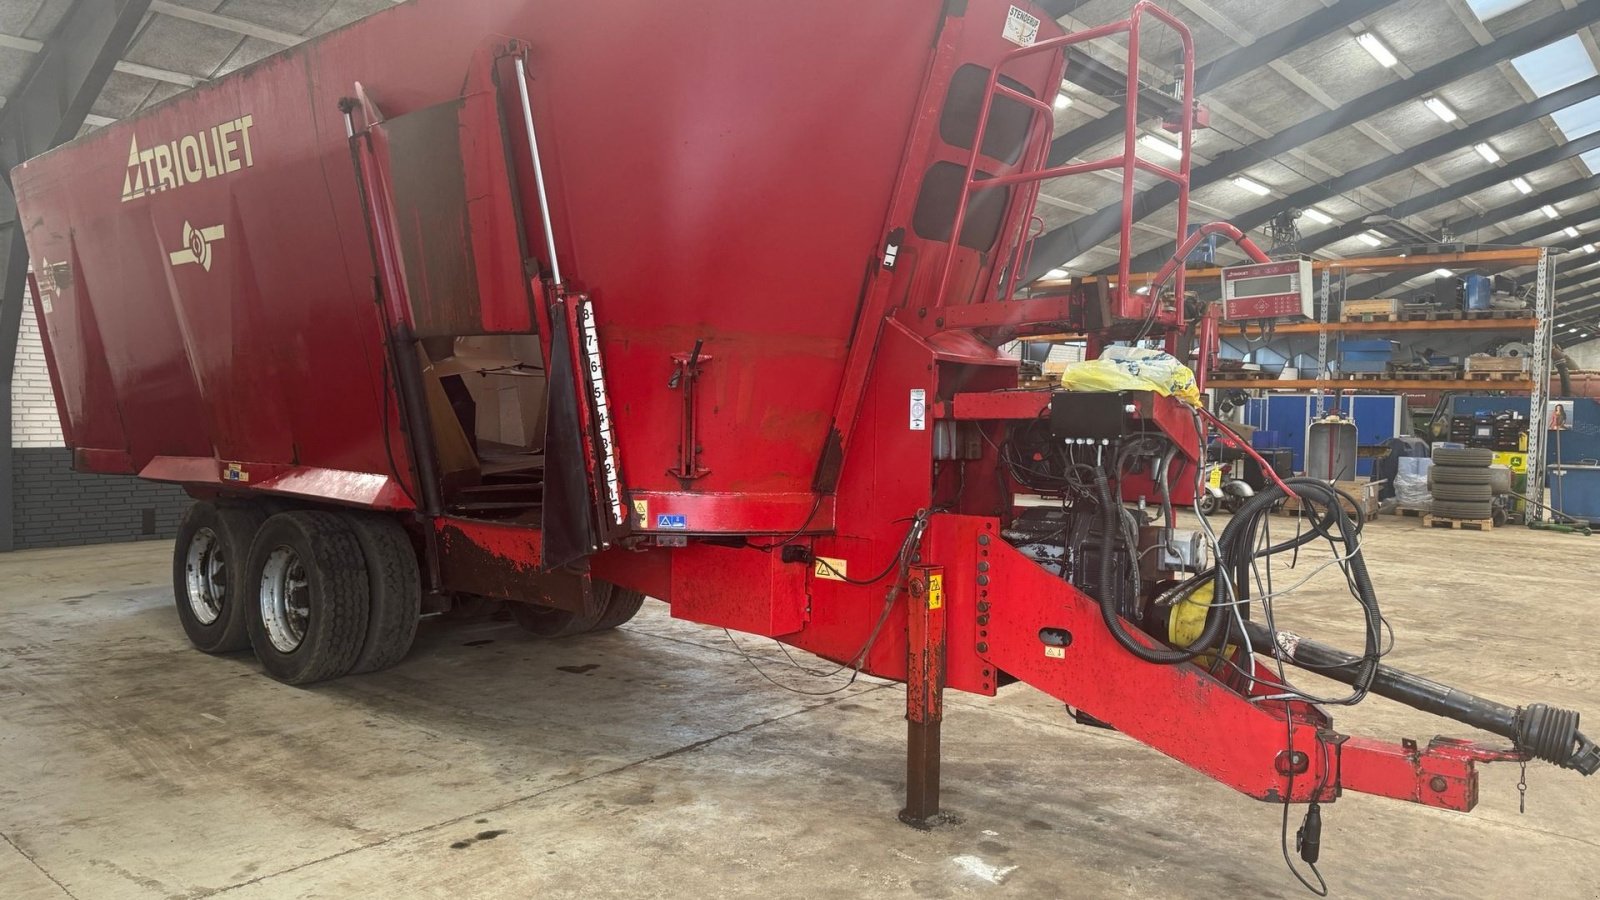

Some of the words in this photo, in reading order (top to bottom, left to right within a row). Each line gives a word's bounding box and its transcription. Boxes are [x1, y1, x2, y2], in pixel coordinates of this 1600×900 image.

[140, 114, 253, 195] TRIOLIET
[583, 308, 590, 320] 8
[586, 335, 593, 346] 7
[591, 361, 598, 372] 6
[594, 387, 601, 398] 5
[600, 412, 605, 423] 4
[603, 438, 608, 449] 3
[605, 463, 611, 474] 2
